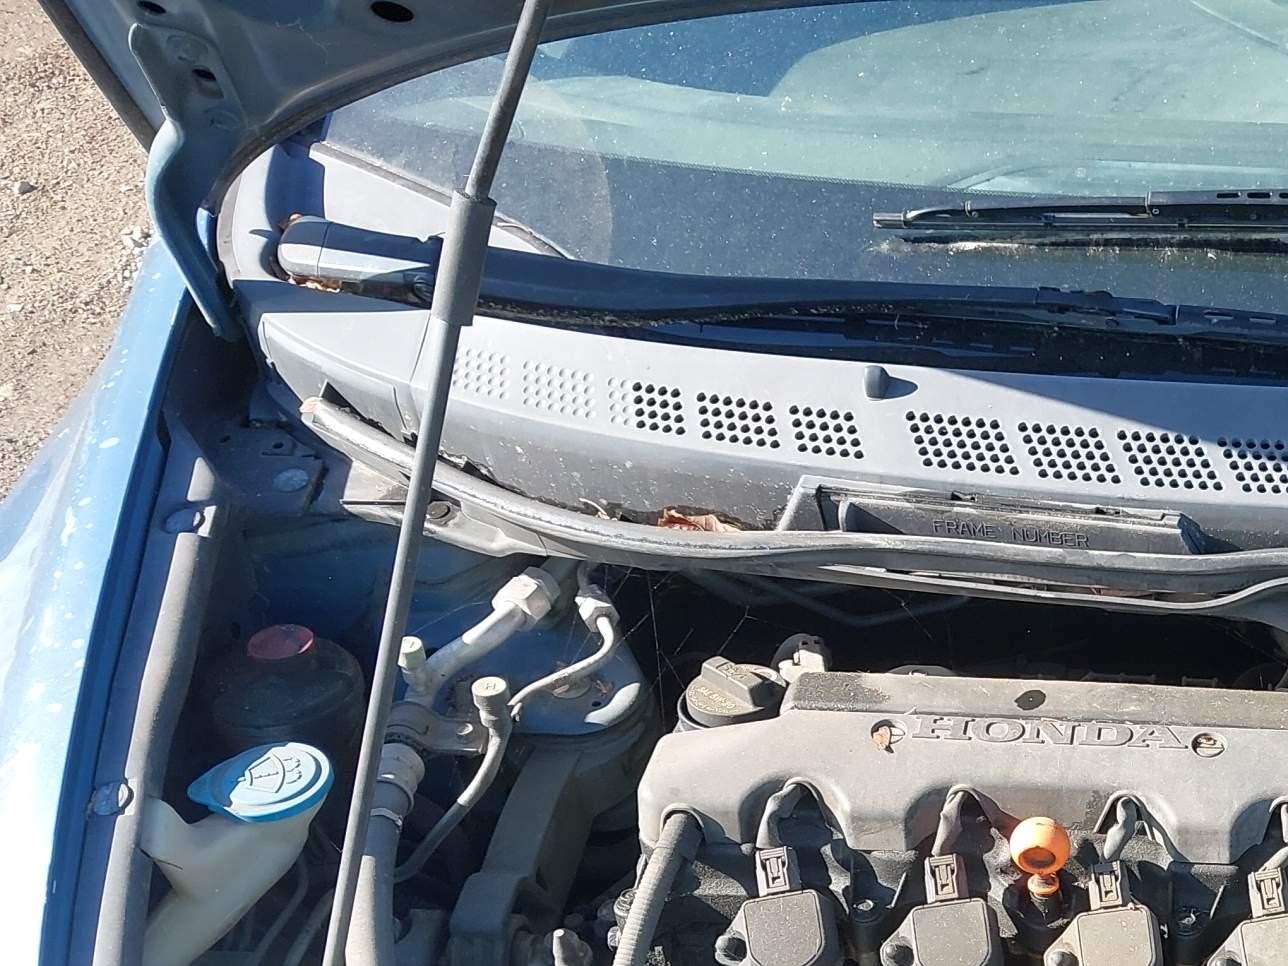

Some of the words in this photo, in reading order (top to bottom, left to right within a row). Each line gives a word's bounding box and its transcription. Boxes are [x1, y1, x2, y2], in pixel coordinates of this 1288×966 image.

[932, 519, 998, 539] FRAME
[1011, 527, 1089, 548] NUMBER
[911, 716, 1189, 749] HONDA
